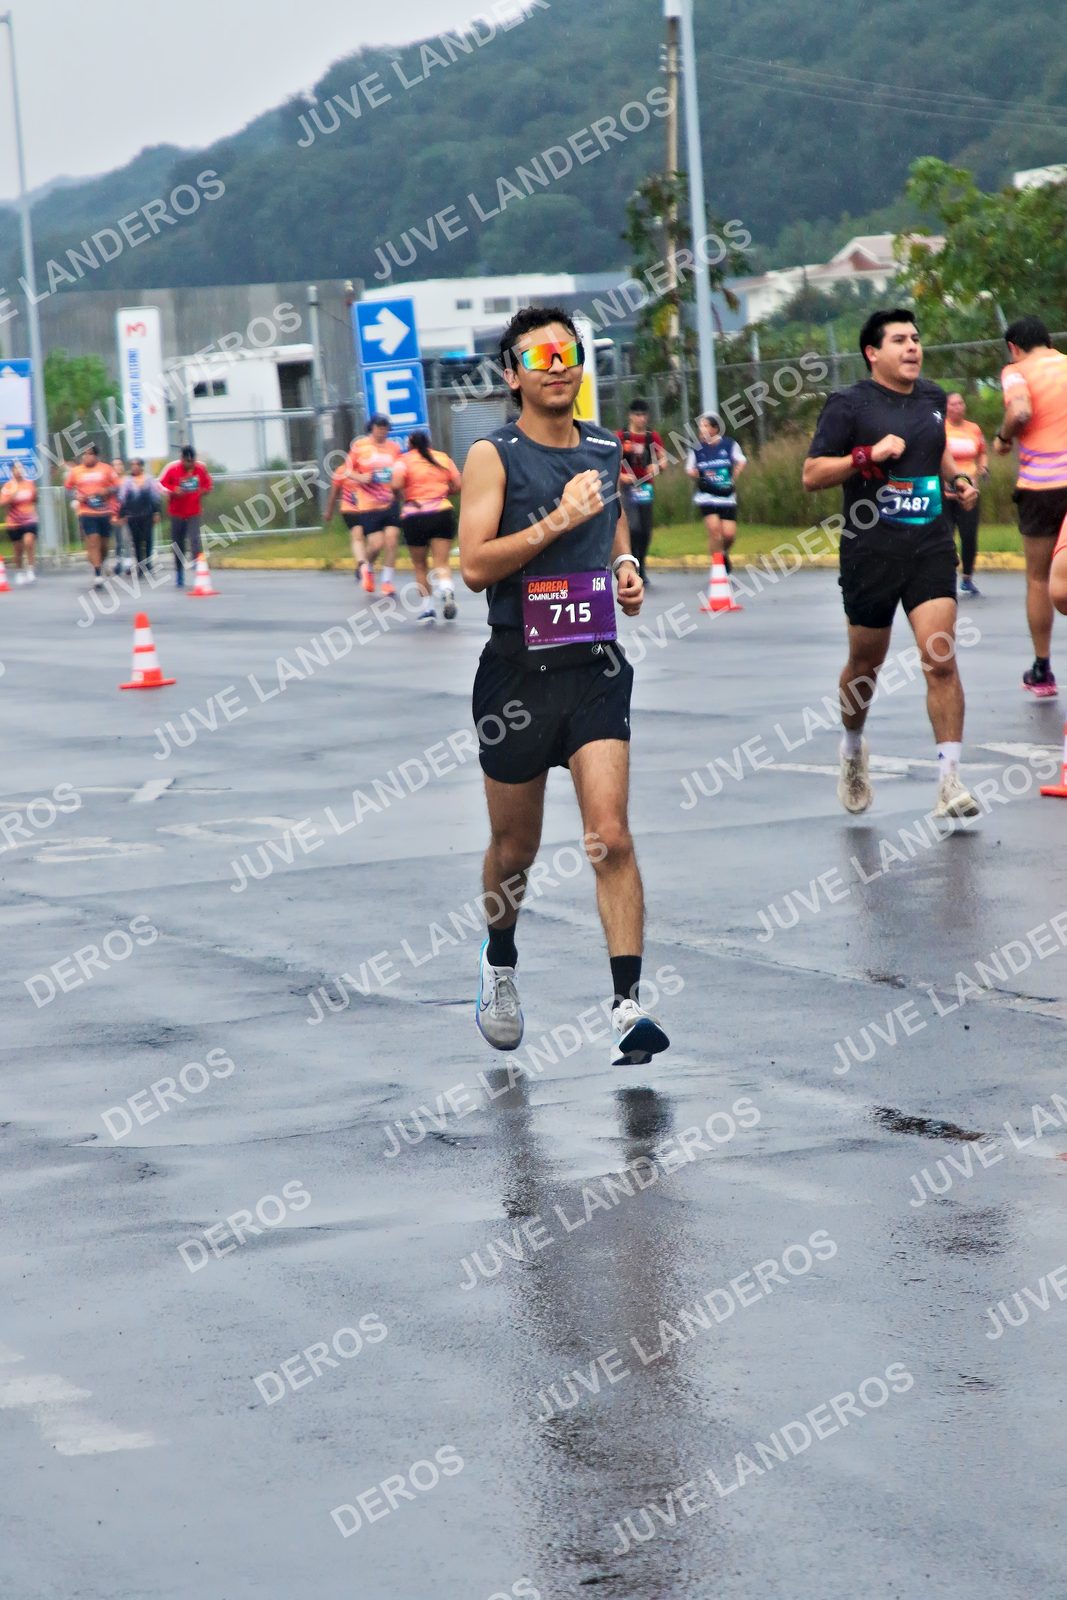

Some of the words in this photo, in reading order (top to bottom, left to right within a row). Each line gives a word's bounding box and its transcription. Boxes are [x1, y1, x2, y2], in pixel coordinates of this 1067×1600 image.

[373, 369, 418, 424] E
[894, 497, 930, 511] 1487
[528, 580, 568, 594] CARRERA
[550, 603, 592, 624] 715
